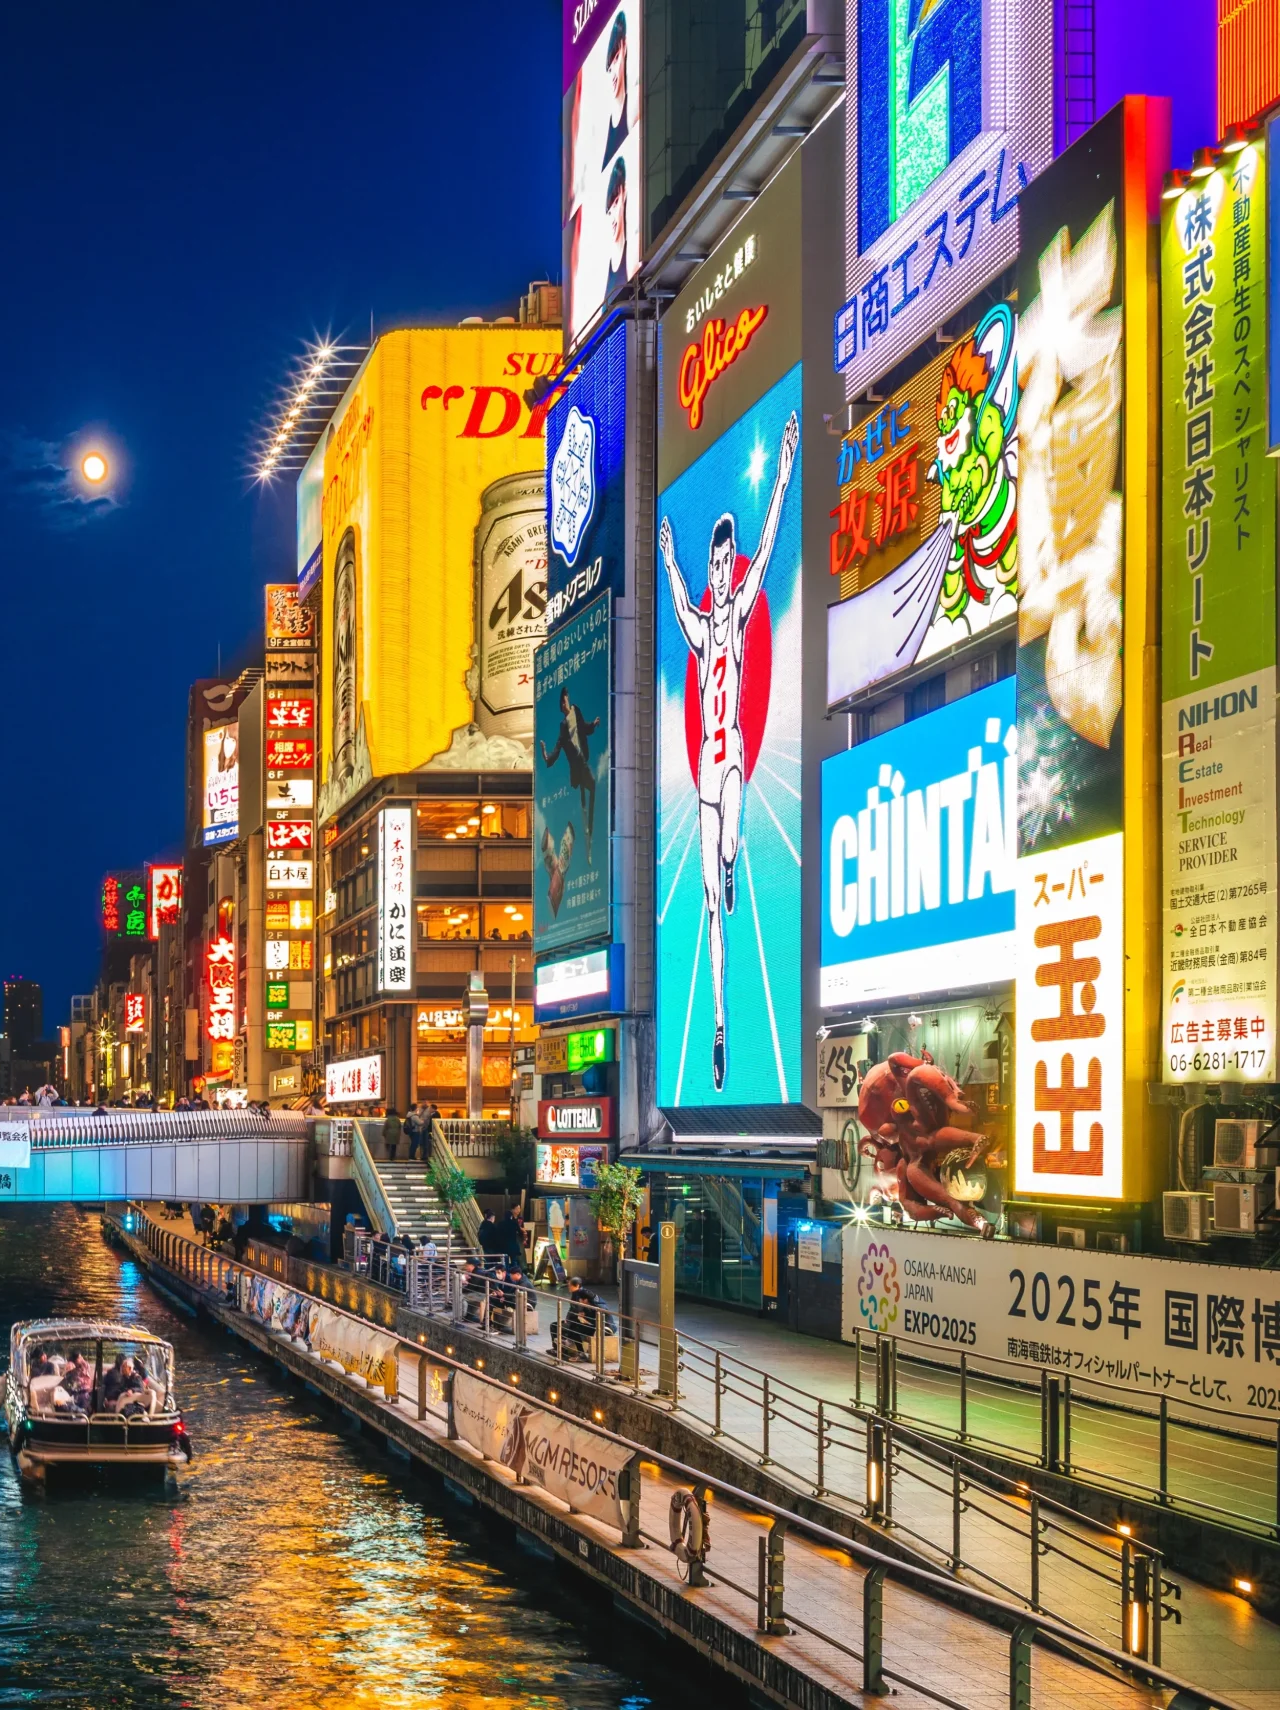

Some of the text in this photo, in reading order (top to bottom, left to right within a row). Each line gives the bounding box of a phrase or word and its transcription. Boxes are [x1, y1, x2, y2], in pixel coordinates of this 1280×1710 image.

[685, 234, 758, 334] おいしさと健康
[680, 304, 769, 430] Glico
[1232, 163, 1252, 550] 不動産再生のスペシャリスト
[836, 401, 911, 486] かぜに
[1183, 193, 1215, 680] 株式会社日本リート
[829, 442, 920, 576] 改源
[504, 534, 525, 558] ASAHI
[712, 646, 727, 765] グリコ
[1178, 685, 1257, 732] NIHON
[268, 753, 312, 766] ダイニング
[1178, 732, 1212, 758] Real
[1179, 759, 1224, 784] Estate
[1179, 781, 1244, 810] Investment
[276, 810, 289, 819] 5F
[1177, 808, 1246, 834] Technology
[1179, 831, 1228, 855] SERVICE
[269, 866, 308, 881] 白木屋
[1179, 847, 1239, 872] PROVIDER
[1033, 861, 1105, 908] スーパー
[1190, 915, 1268, 939] 全日本不動産協会
[389, 902, 406, 984] かに道楽
[1170, 948, 1268, 972] 近畿財務局長(金商)第84号
[207, 938, 235, 1040] 大阪王将
[1170, 1015, 1265, 1044] 広告主募集中
[1031, 915, 1106, 1177] 玉出
[1170, 1050, 1266, 1072] 06-6281-1717
[556, 1107, 598, 1130] LOTTERIA
[904, 1259, 977, 1286] OSAKA-KANSAI
[904, 1282, 934, 1304] JAPAN
[1008, 1267, 1142, 1341] 2025年
[1007, 1336, 1232, 1403] 南海電鉄はオフィシャルパートナーとして、
[525, 1430, 560, 1471] MGM
